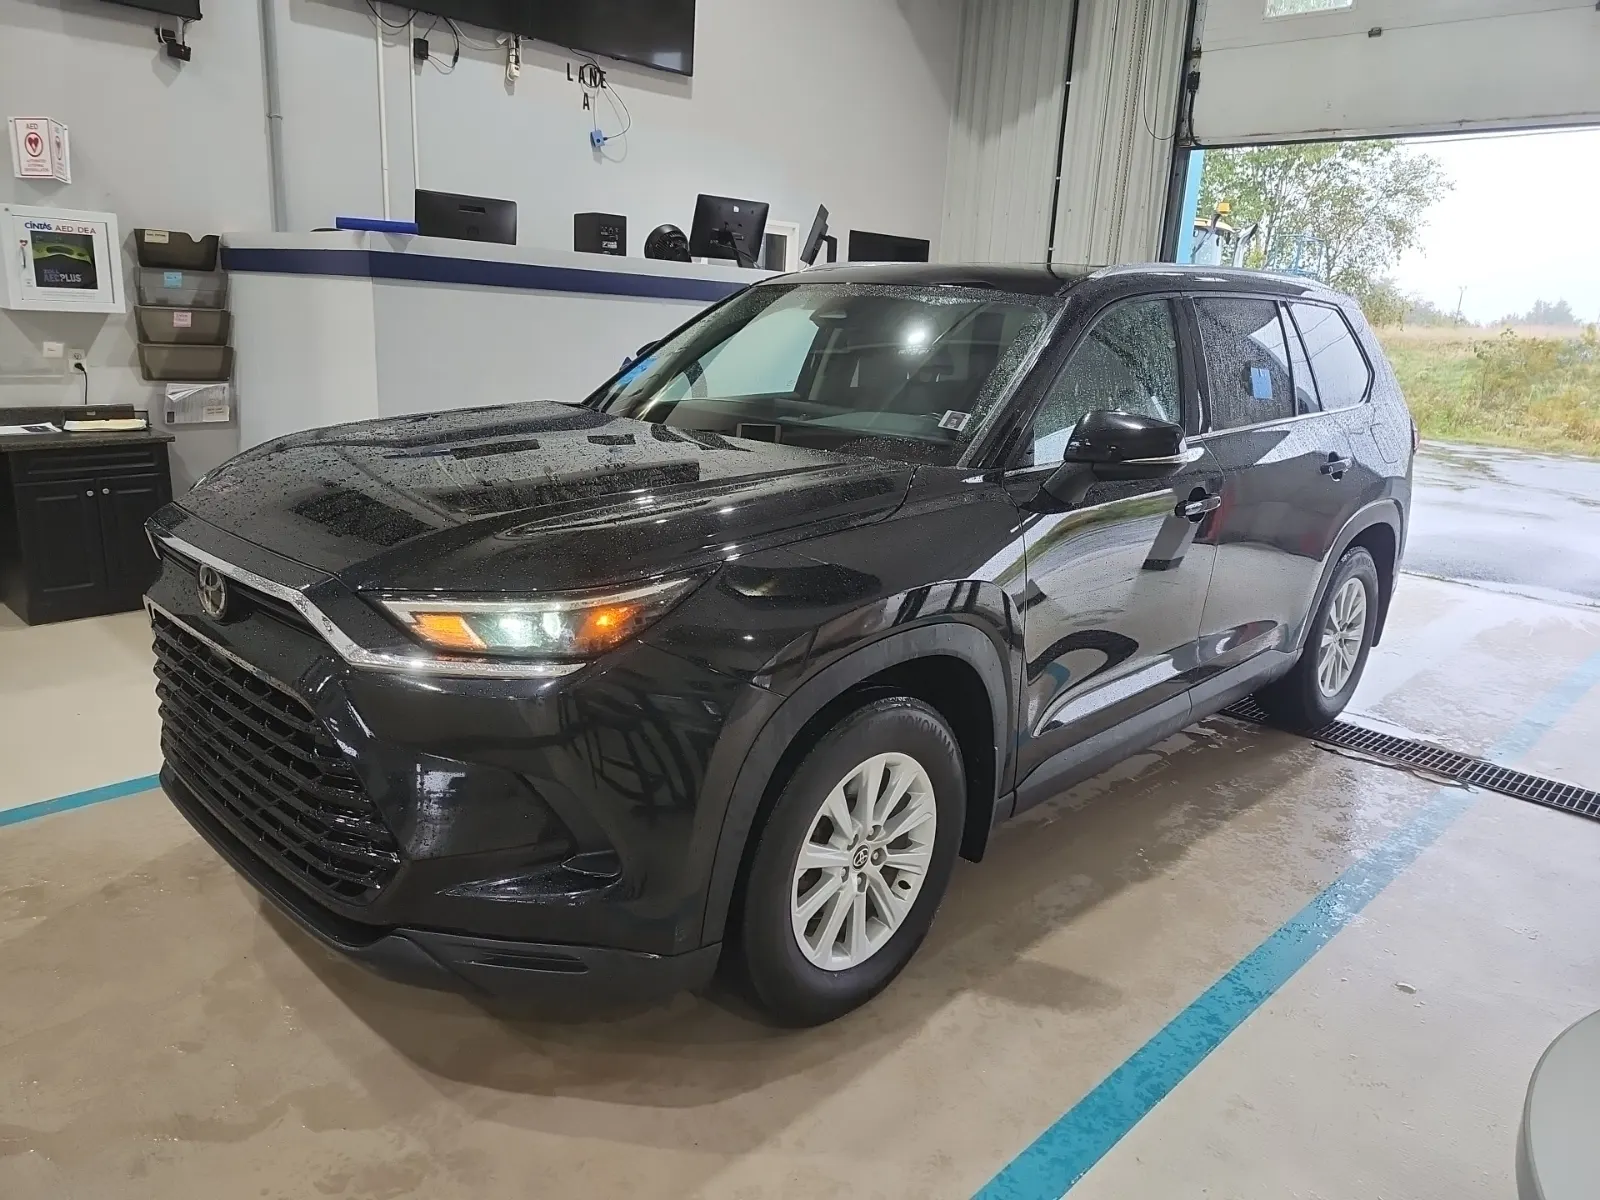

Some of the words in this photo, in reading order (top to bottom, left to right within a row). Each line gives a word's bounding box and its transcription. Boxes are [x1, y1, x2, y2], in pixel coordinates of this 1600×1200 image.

[566, 62, 607, 89] LANE
[582, 92, 590, 110] A
[77, 226, 97, 234] DEA
